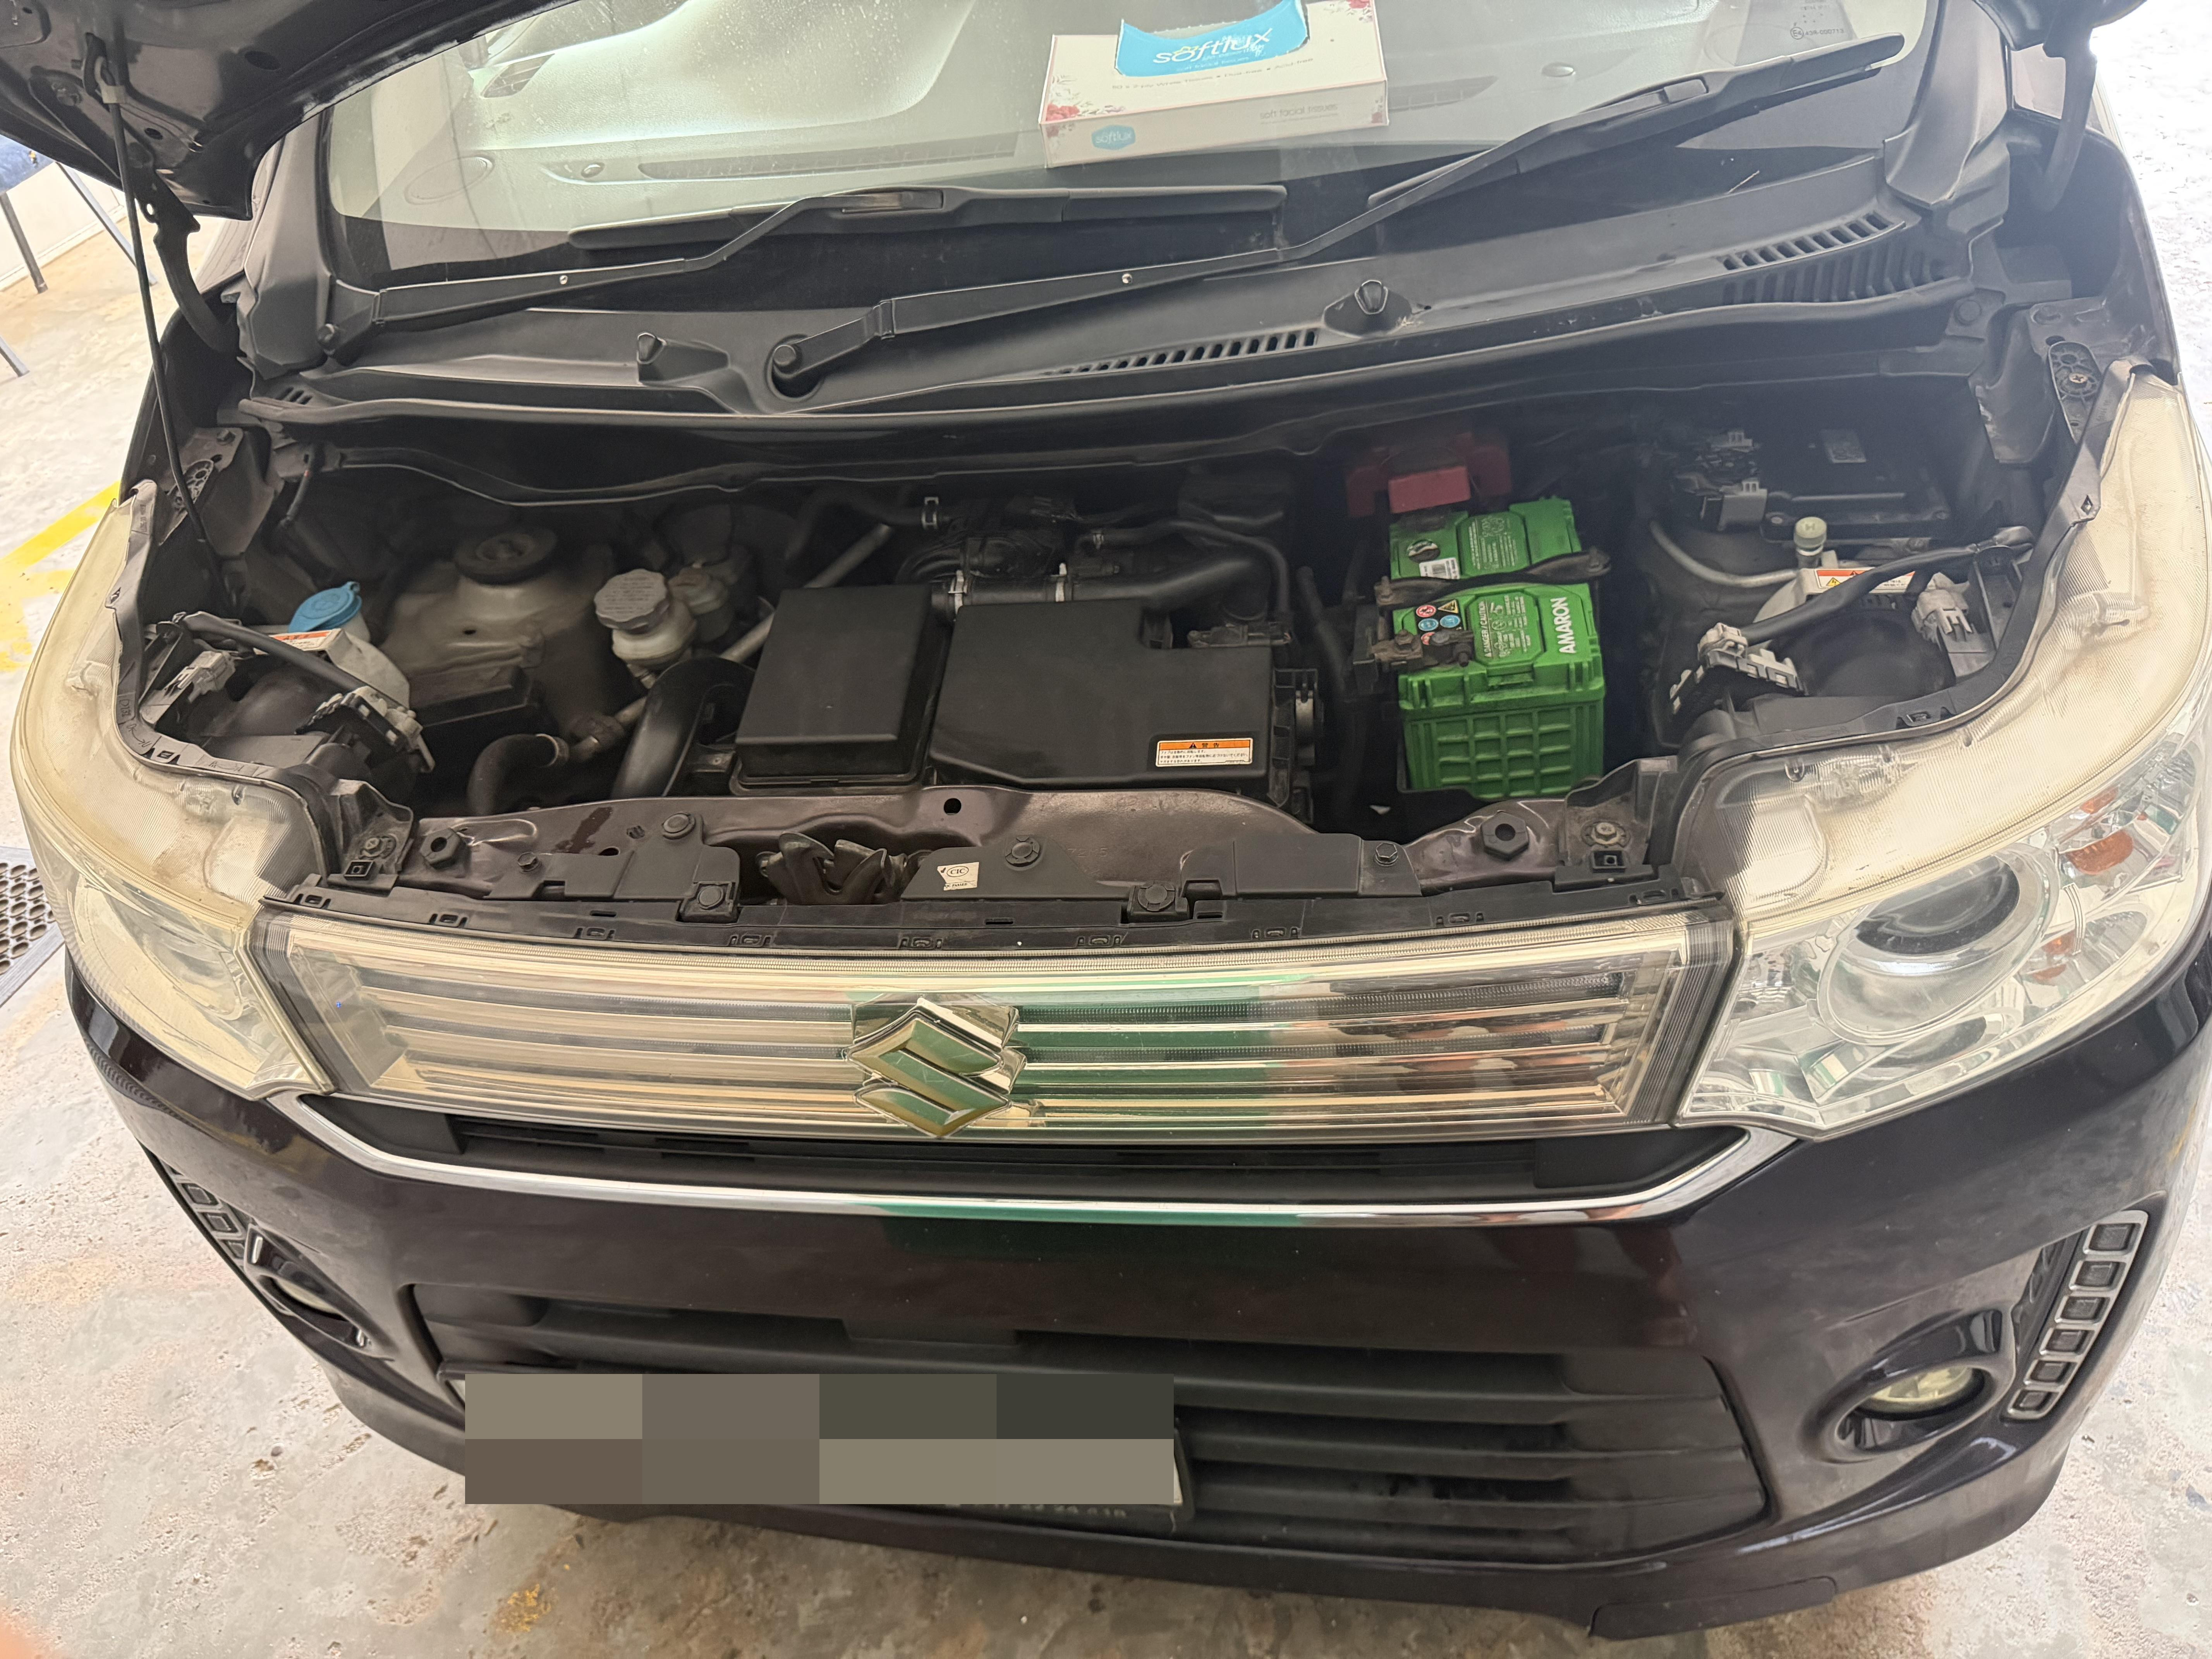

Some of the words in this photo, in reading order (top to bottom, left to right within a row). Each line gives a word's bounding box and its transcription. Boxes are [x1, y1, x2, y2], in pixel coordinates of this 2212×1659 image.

[1153, 28, 1273, 64] softlux
[1479, 601, 1487, 625] CAUTION
[1550, 597, 1577, 654] AMARON
[1481, 629, 1491, 652] DANGER
